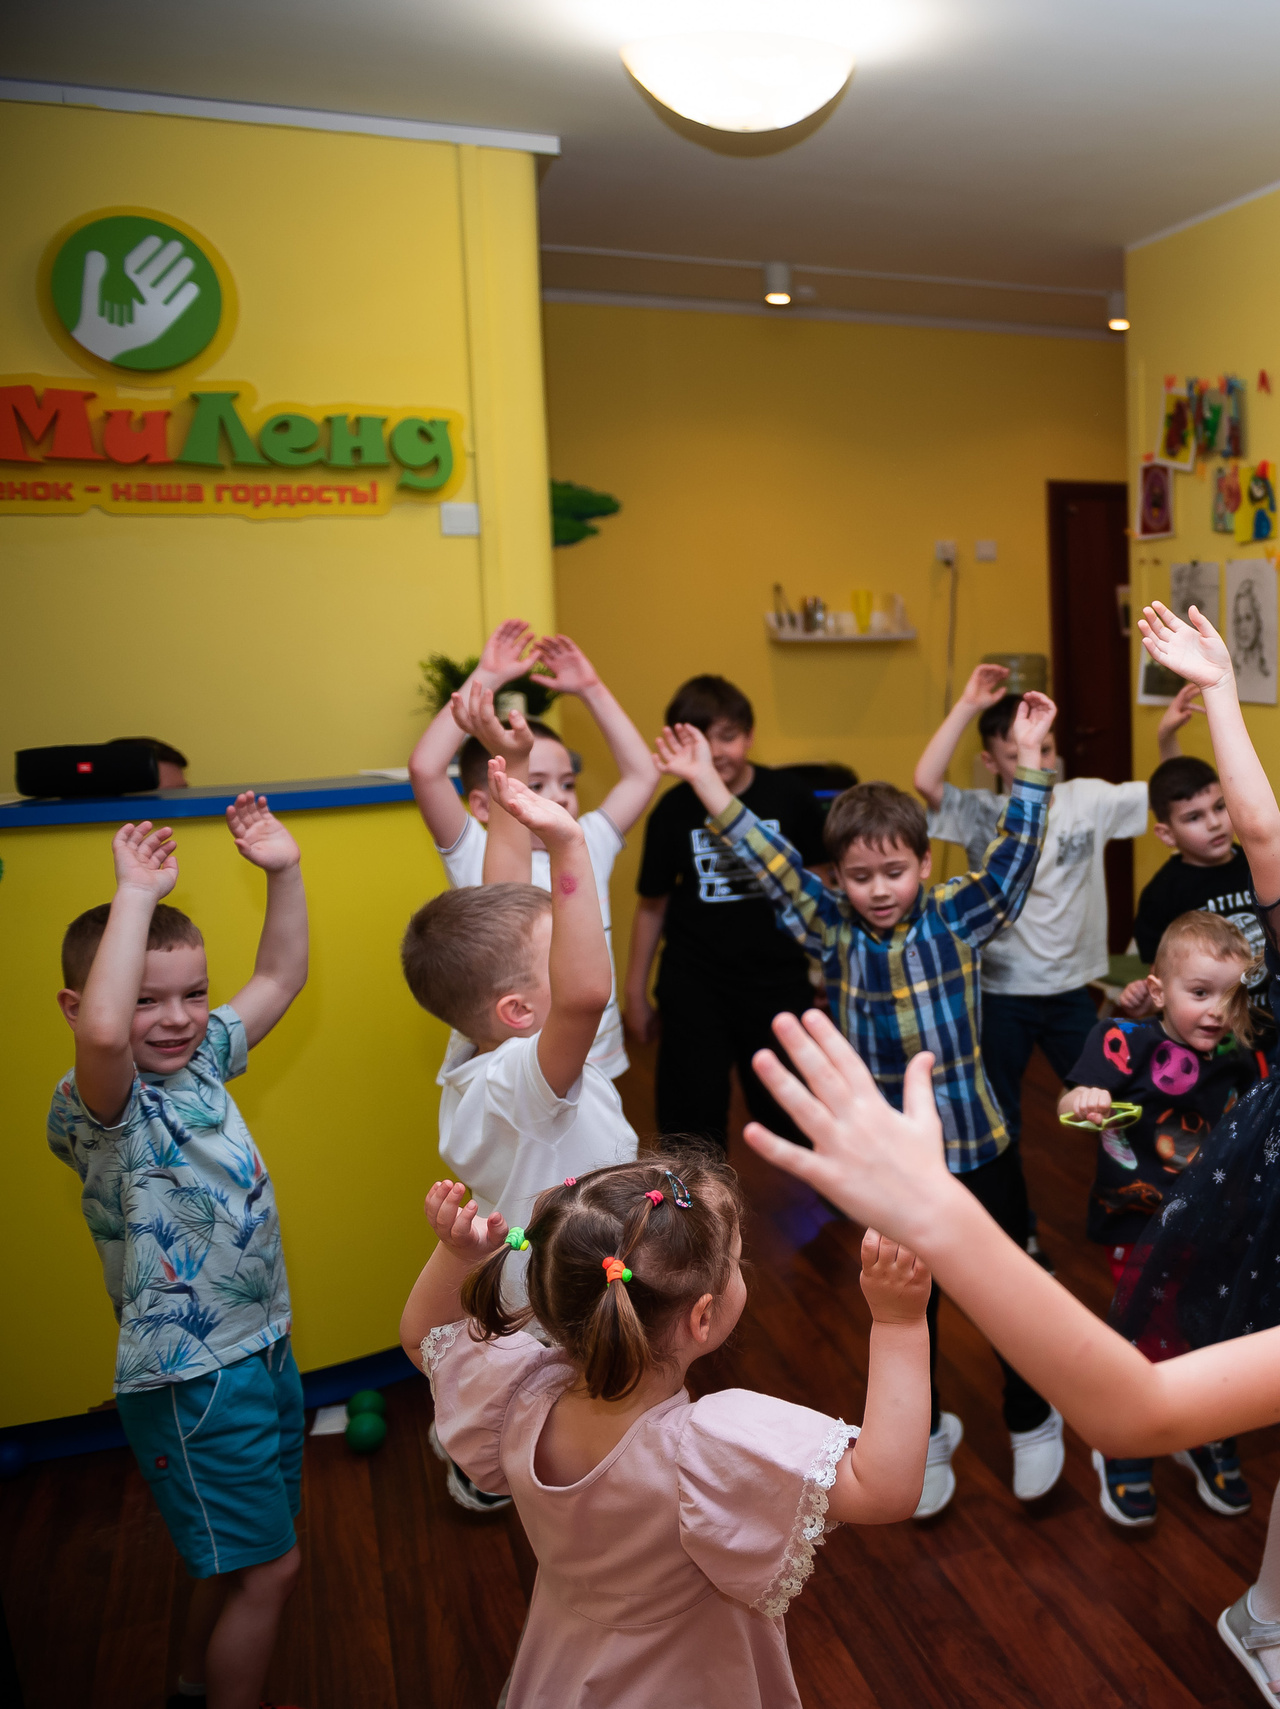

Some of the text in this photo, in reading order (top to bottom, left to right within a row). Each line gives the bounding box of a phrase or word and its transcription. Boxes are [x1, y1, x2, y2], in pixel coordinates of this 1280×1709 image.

[112, 482, 205, 502] наша
[215, 480, 378, 507] гордость!
[1207, 890, 1253, 912] ATTAC
